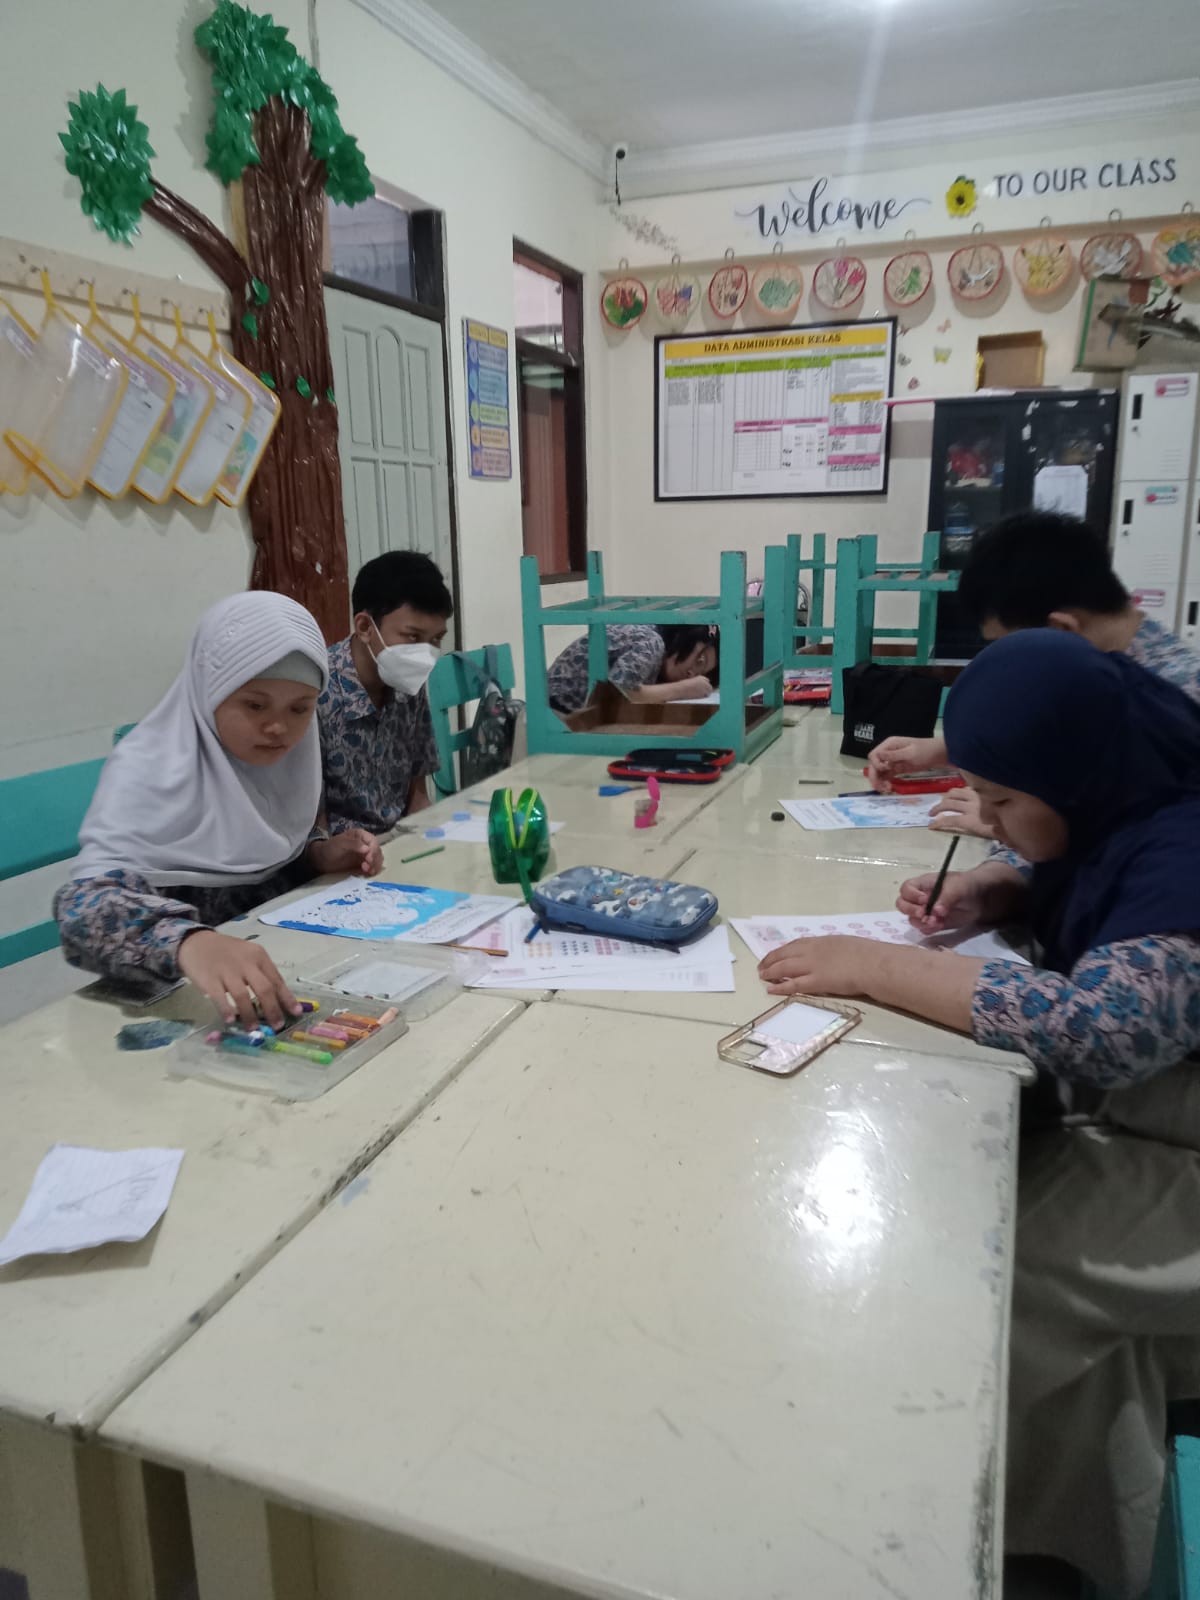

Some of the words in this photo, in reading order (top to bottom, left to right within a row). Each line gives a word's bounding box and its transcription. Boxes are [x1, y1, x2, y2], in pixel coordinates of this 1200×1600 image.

[993, 173, 1023, 198] TO
[1033, 167, 1087, 195] OUR
[1098, 158, 1177, 189] CLASS
[704, 342, 730, 353] DATA
[732, 335, 805, 350] ADMINISTRASI
[808, 333, 842, 344] KELAS
